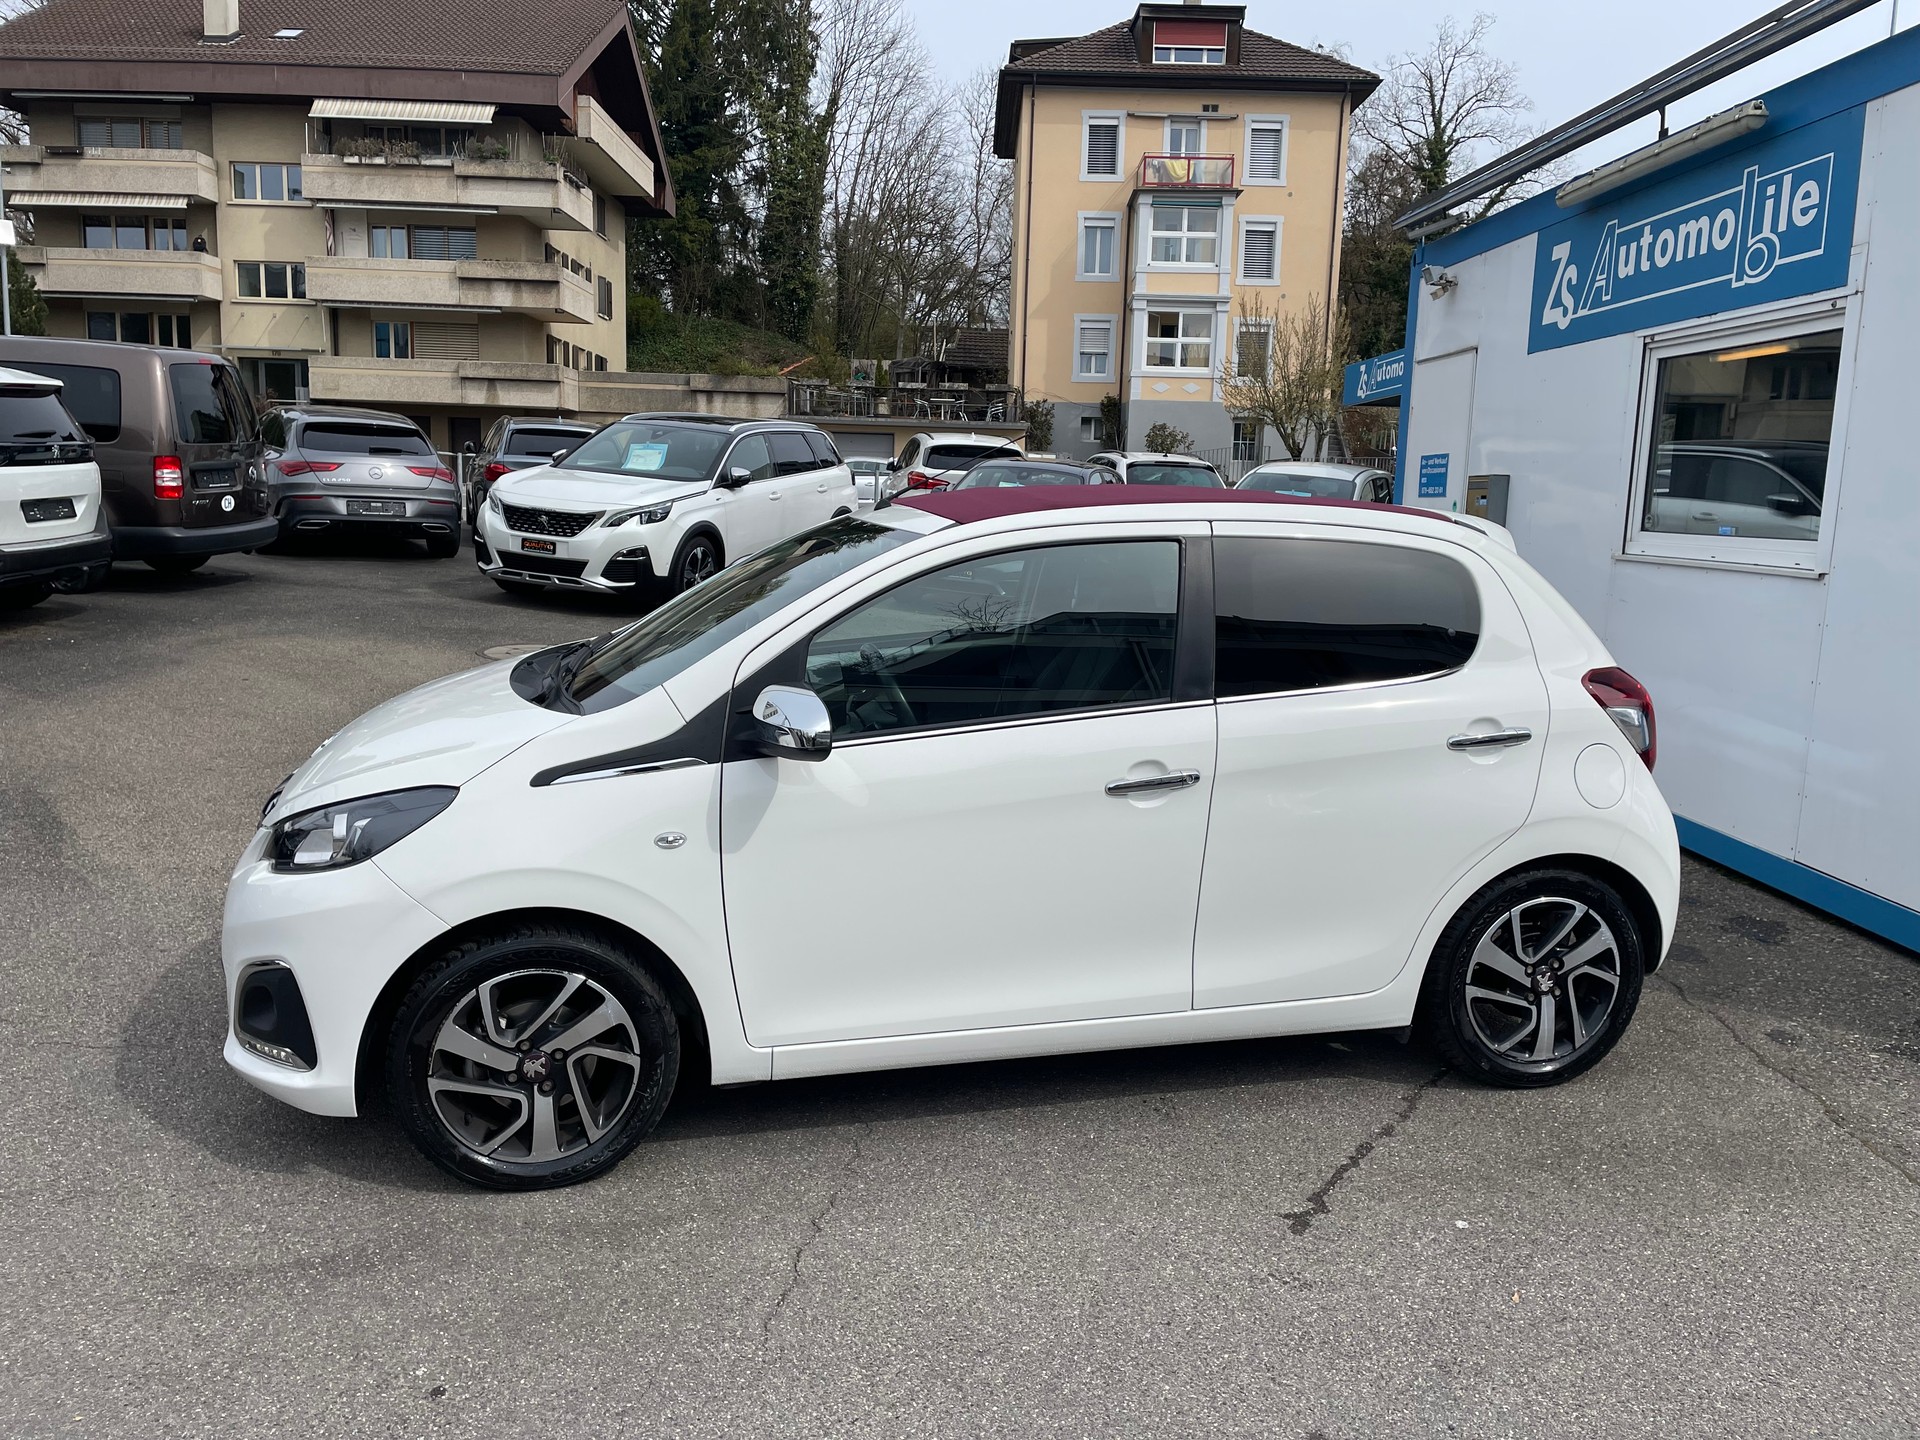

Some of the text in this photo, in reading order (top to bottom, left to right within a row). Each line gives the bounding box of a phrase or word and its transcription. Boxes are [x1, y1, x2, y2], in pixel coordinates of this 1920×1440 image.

[1541, 165, 1820, 330] Zs Automobile
[1357, 364, 1367, 399] Zs
[224, 498, 232, 509] CH
[523, 541, 548, 549] QUALITY
